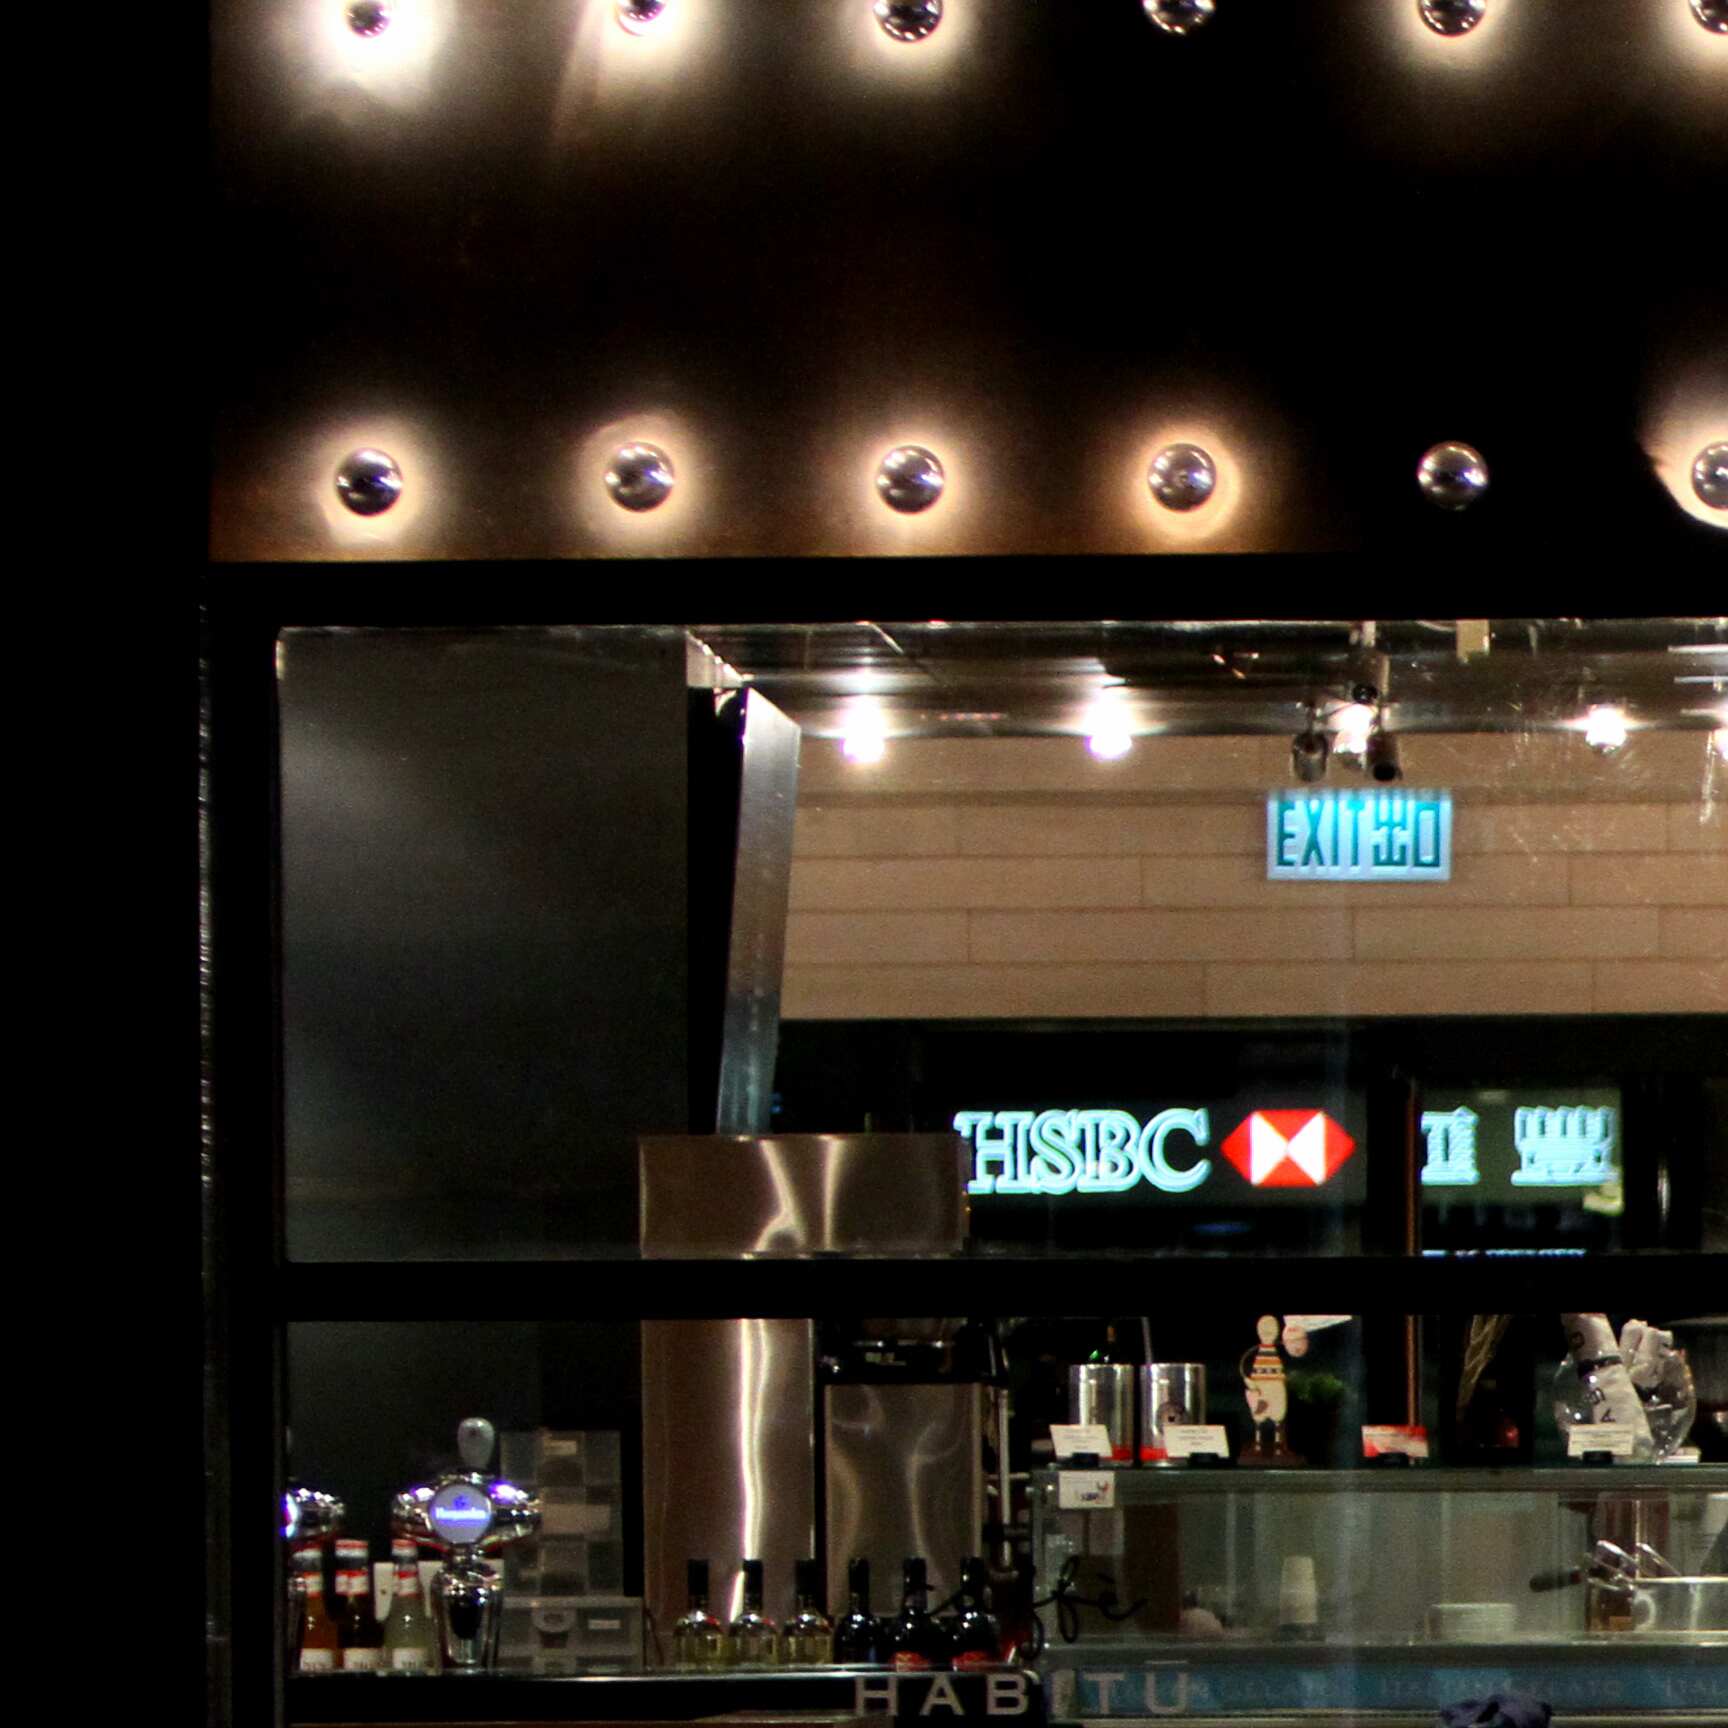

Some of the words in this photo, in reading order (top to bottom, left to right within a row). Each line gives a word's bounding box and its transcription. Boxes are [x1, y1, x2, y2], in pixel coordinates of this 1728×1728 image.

[1276, 792, 1366, 867] EXIT
[1372, 792, 1441, 867] 出口
[953, 1107, 1213, 1195] HSBC
